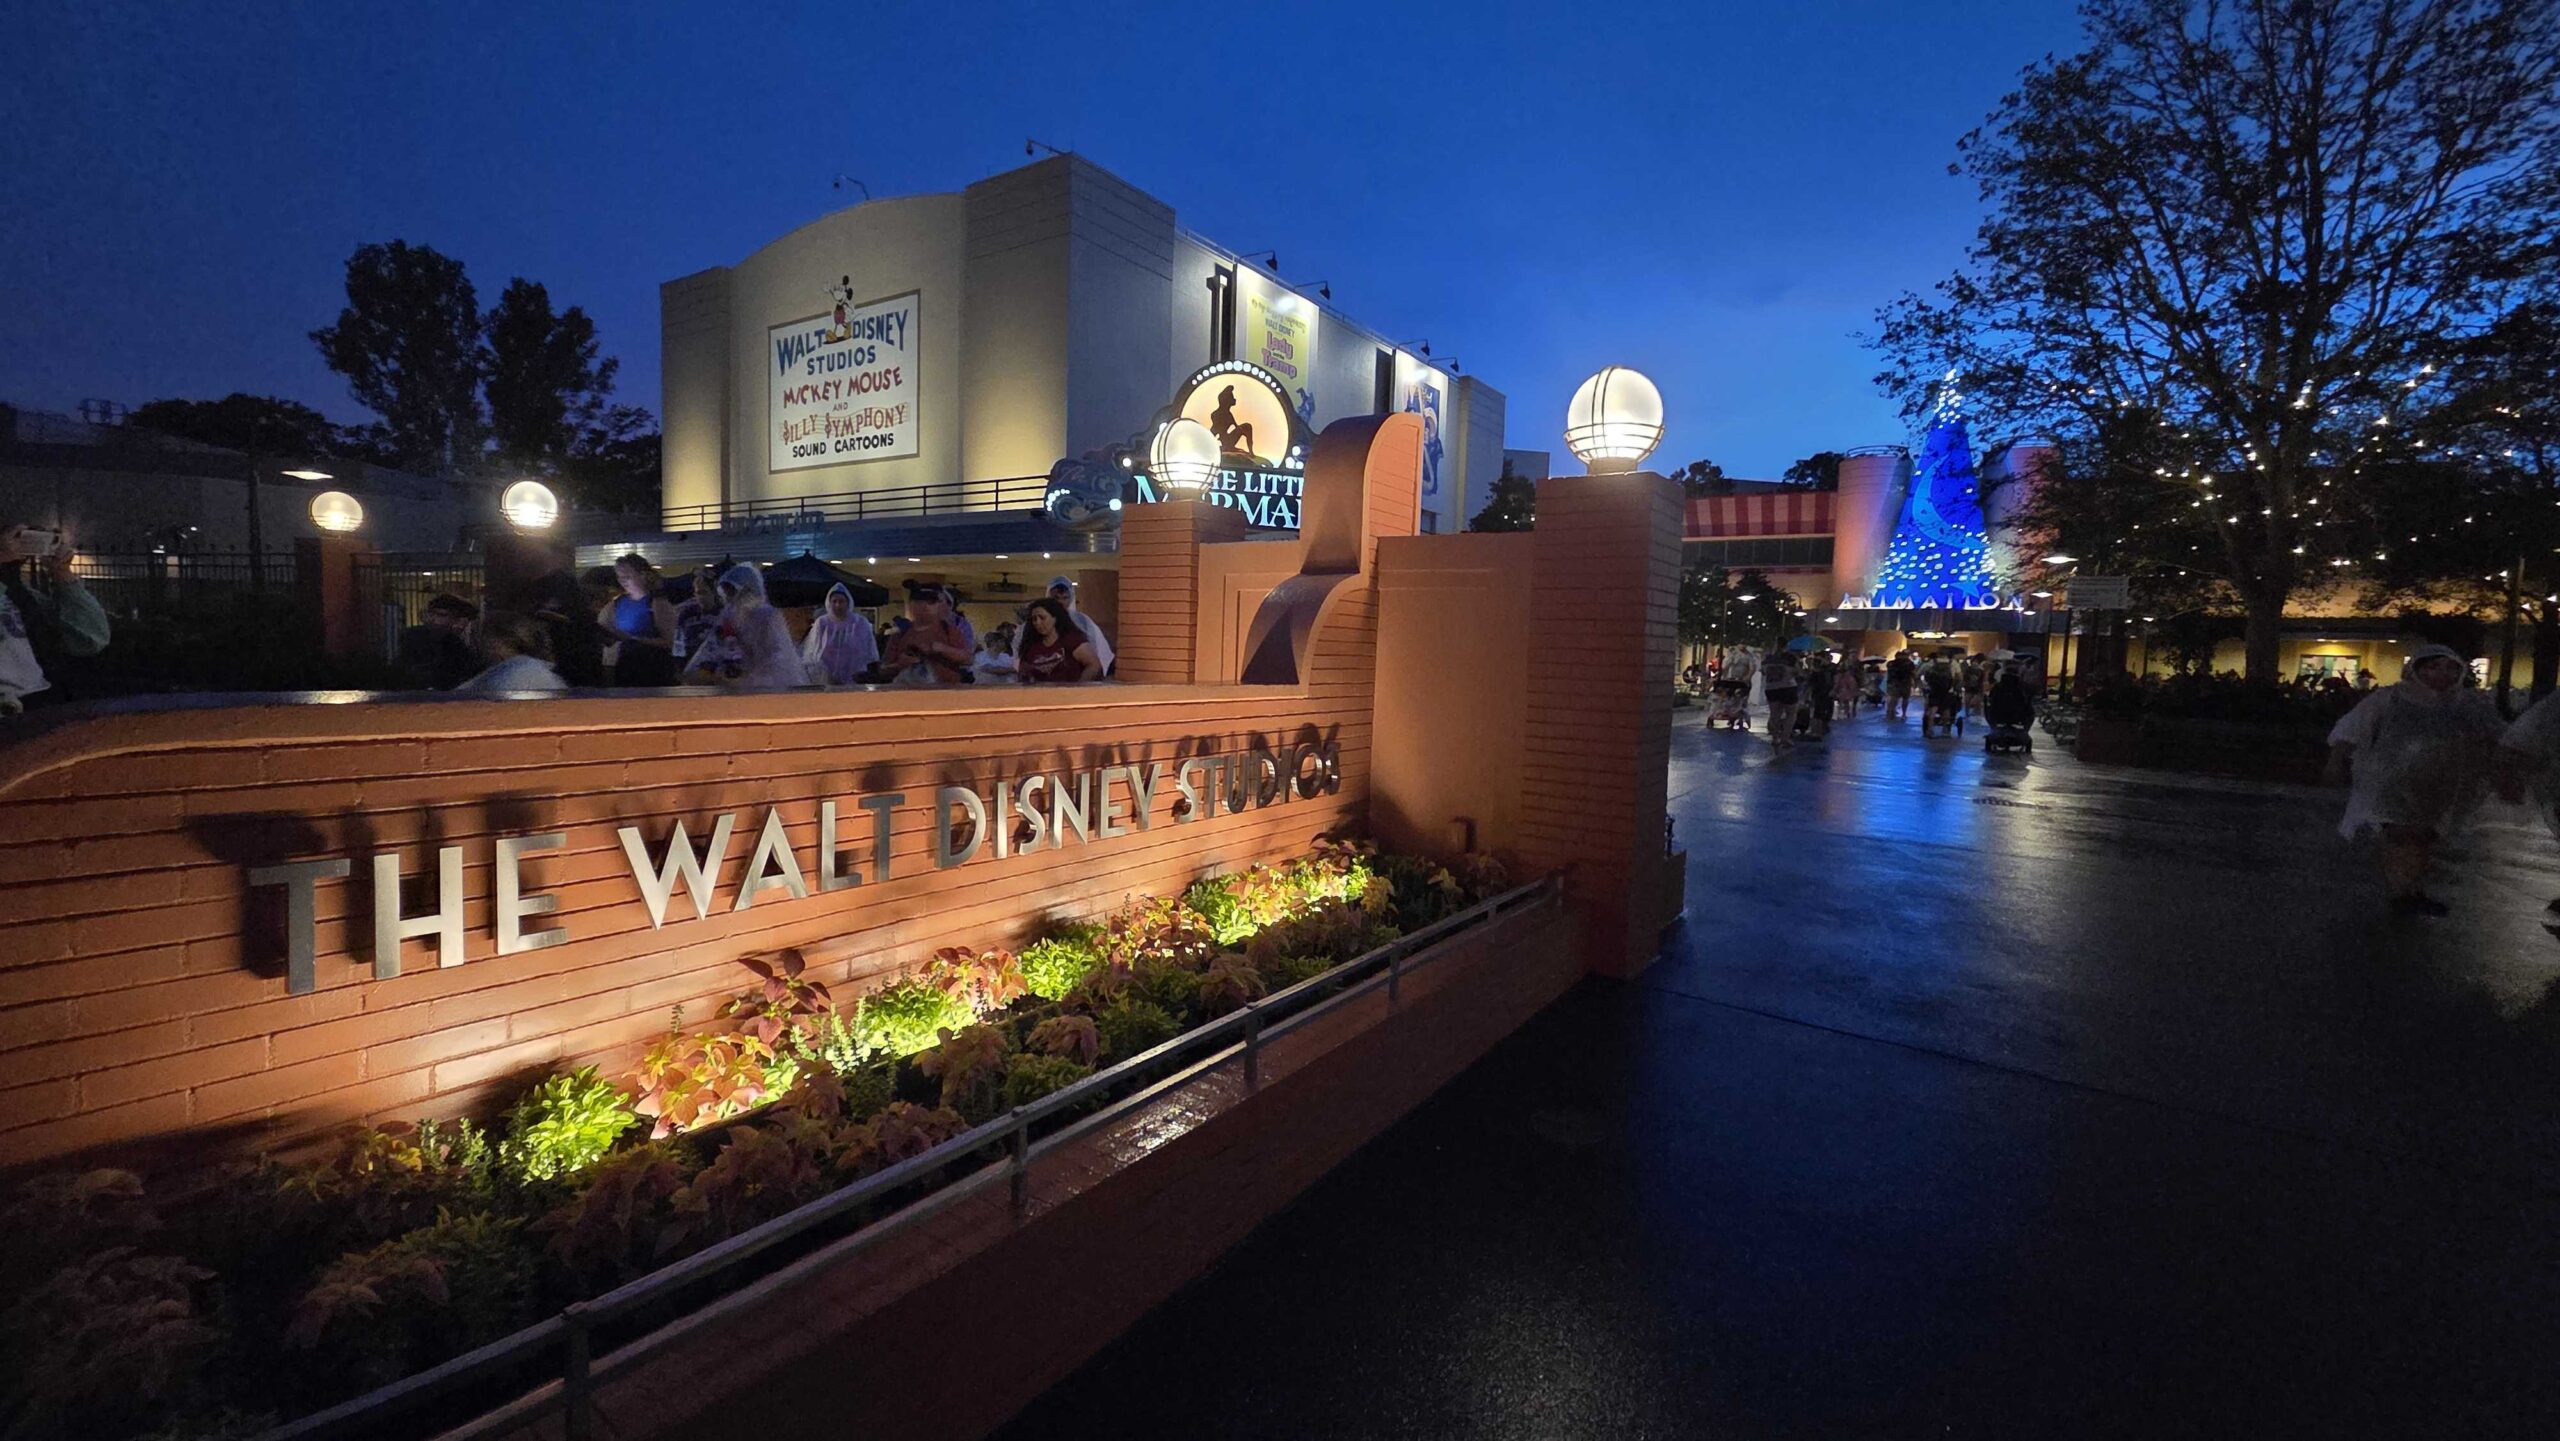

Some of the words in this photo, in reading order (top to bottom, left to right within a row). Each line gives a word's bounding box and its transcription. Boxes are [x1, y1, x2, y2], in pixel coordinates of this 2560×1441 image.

[777, 328, 825, 376] WALT
[852, 309, 908, 351] DISNEY
[1267, 331, 1293, 360] Lady
[807, 345, 875, 375] STUDIOS
[1262, 348, 1297, 379] Tramp
[783, 379, 842, 408] MICKEY
[847, 366, 902, 397] MOUSE
[832, 402, 848, 412] AND
[783, 414, 817, 445] SILLY
[825, 404, 906, 439] SYMPHONY
[793, 442, 826, 458] SOUND
[834, 433, 894, 454] CARTOONS
[249, 833, 566, 994] THE
[617, 793, 905, 930] WALT
[935, 763, 1162, 871] DISNEY
[1173, 742, 1341, 824] STUDIOS
